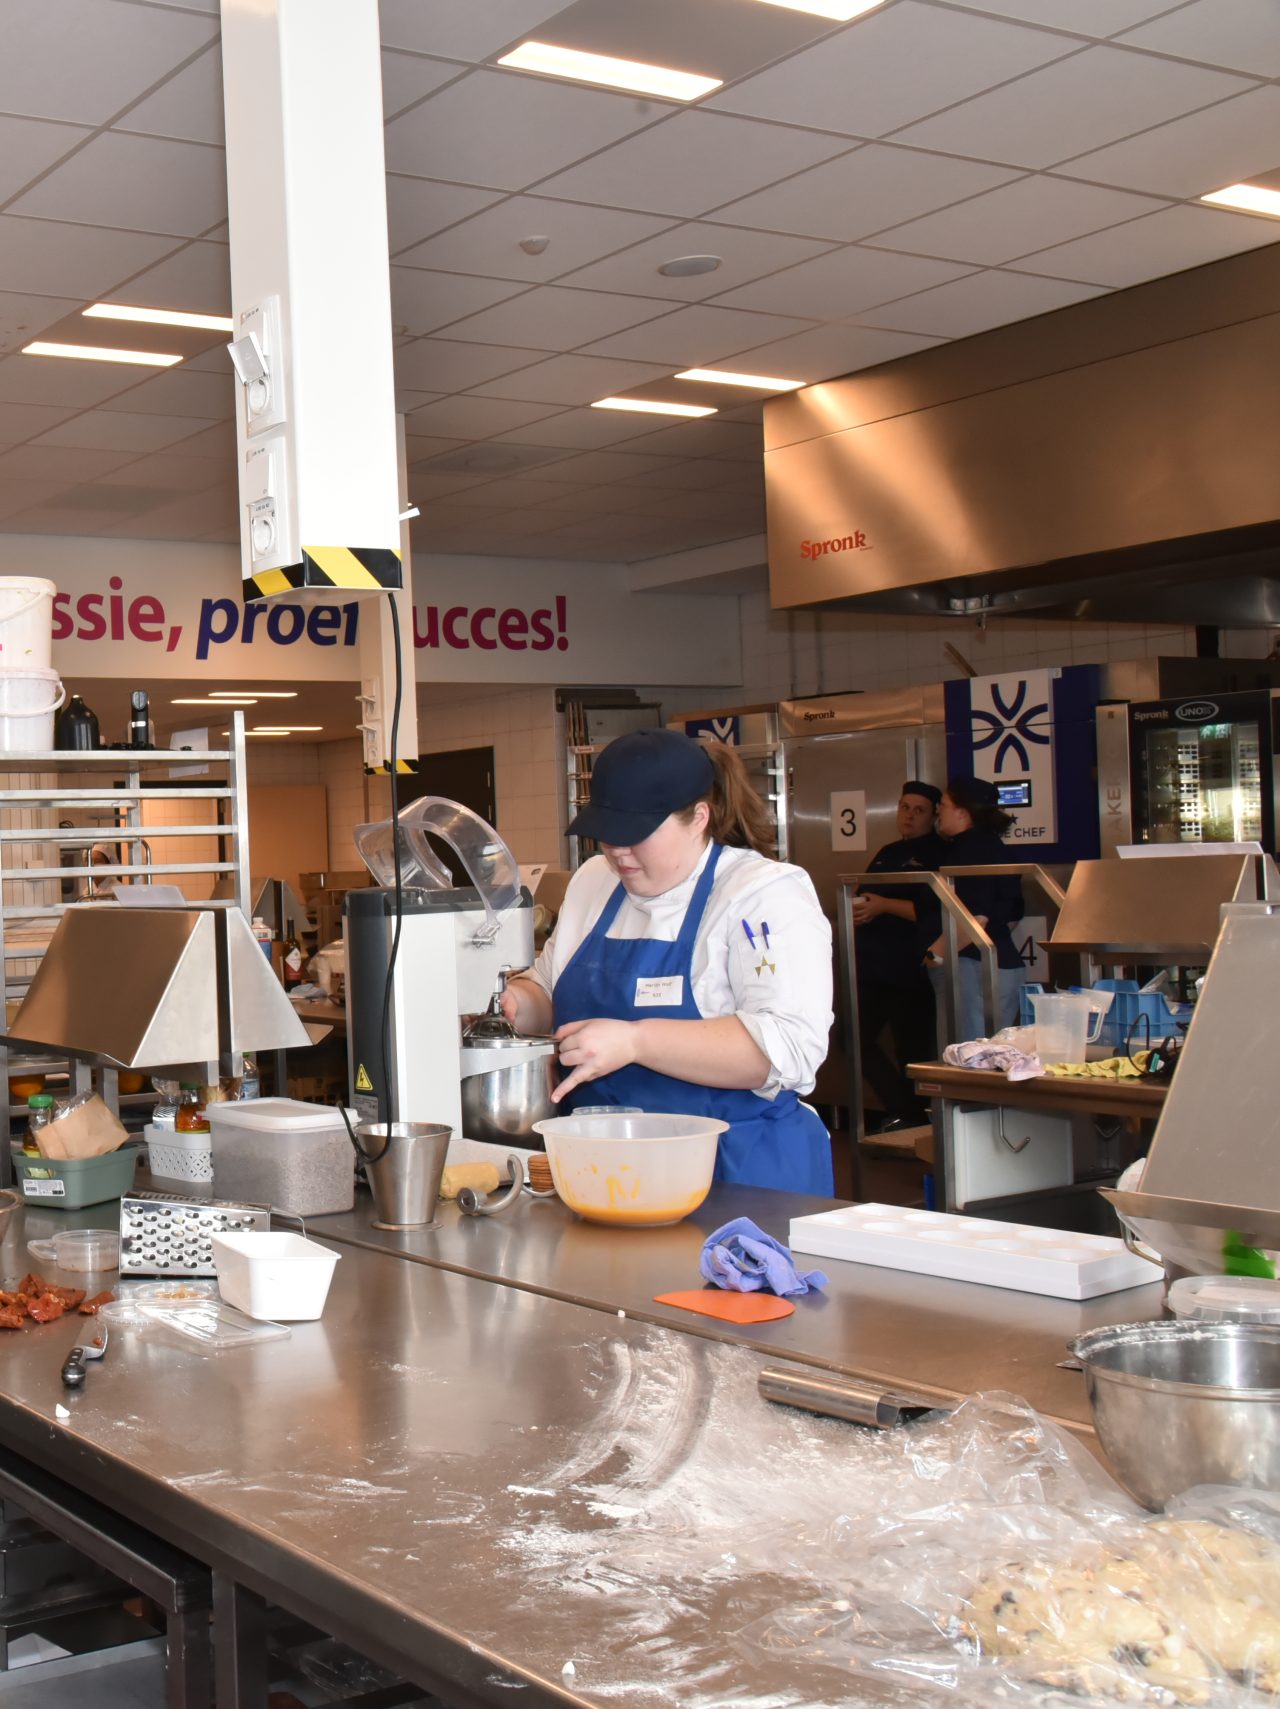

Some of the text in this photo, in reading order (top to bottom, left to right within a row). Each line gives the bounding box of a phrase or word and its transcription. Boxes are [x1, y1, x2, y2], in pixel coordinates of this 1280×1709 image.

[800, 529, 866, 561] Spronk
[51, 576, 182, 652] ssie,
[412, 596, 568, 651] ucces!
[803, 710, 836, 722] Spronk
[840, 808, 857, 837] 3
[1014, 826, 1046, 838] CHEF
[1019, 935, 1038, 967] 4
